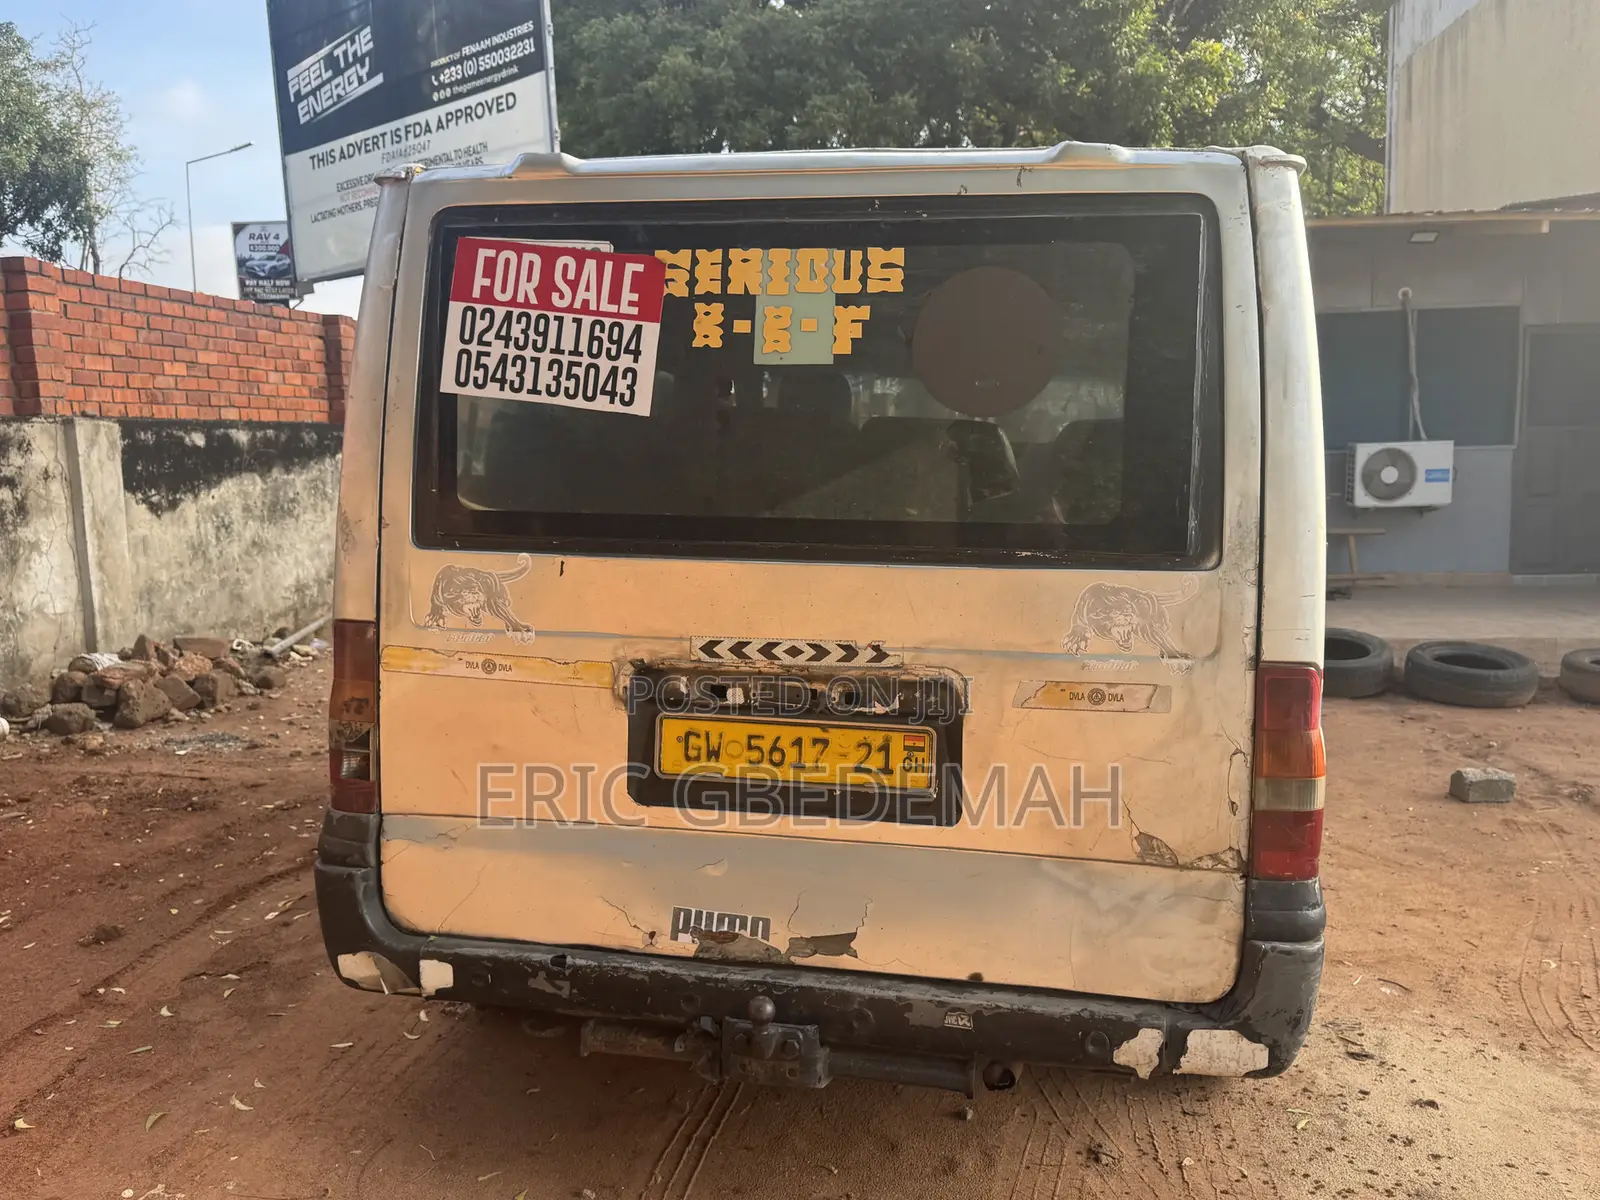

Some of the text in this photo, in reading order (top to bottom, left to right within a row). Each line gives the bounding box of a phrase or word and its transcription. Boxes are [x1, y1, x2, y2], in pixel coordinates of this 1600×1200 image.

[439, 37, 535, 84] +233 (0) 550032231
[461, 37, 492, 57] FENAAM
[492, 20, 534, 46] INDUSTRIES
[286, 25, 374, 103] FEEL THE
[297, 56, 370, 125] ENERGY
[308, 91, 517, 170] THIS ADVERT IS FDA APPROVED
[462, 141, 489, 158] HEALTH
[249, 232, 280, 241] RAV 4
[472, 248, 645, 315] FOR SALE
[655, 247, 905, 298] SERIOUS
[459, 306, 643, 364] 0243911694
[454, 348, 638, 407] 0543135043
[465, 660, 513, 673] DVLA DVLA
[1068, 691, 1125, 702] DVLA DVLA
[683, 729, 895, 776] GW 5617 21
[902, 755, 926, 774] GH
